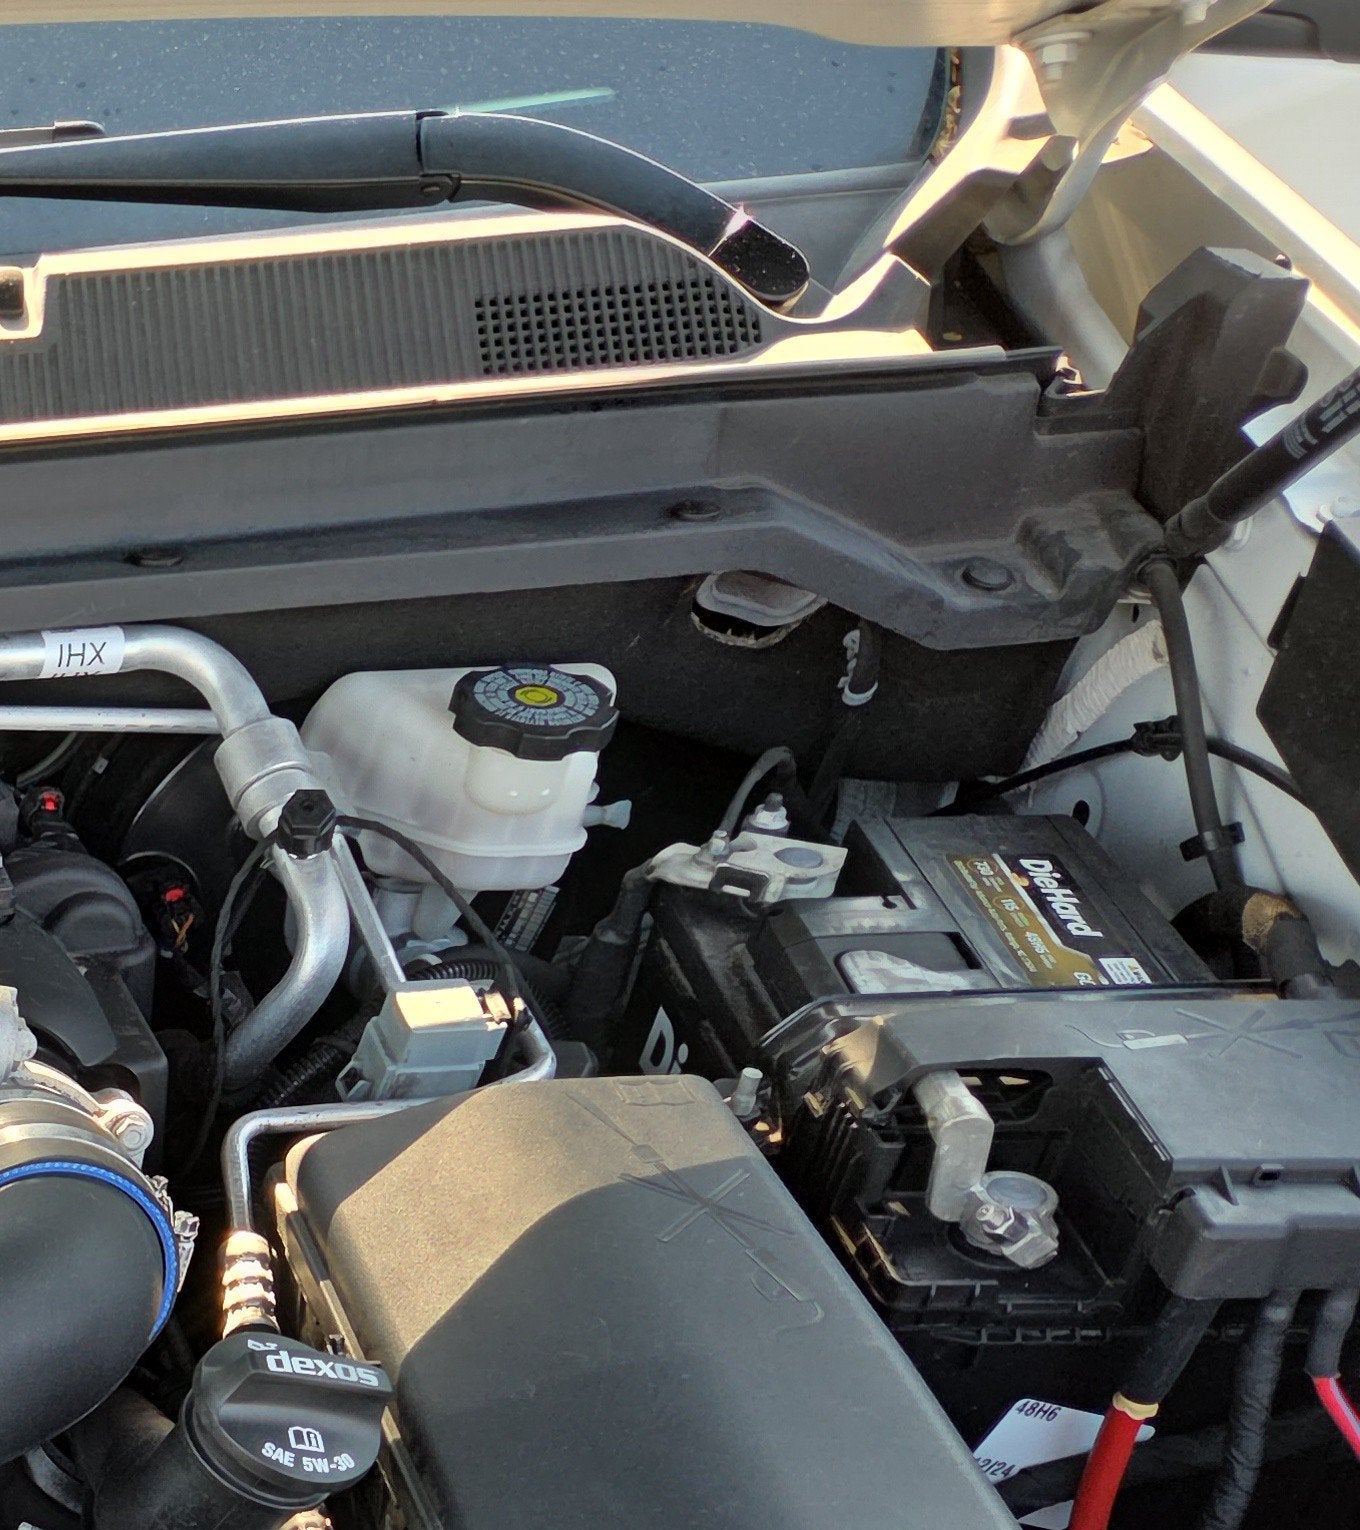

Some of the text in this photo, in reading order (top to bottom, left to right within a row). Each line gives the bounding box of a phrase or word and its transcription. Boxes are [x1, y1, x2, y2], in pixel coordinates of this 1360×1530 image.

[1019, 859, 1103, 937] DieHard
[265, 1350, 379, 1387] dexos
[1014, 1400, 1062, 1422] 48H6
[261, 1441, 355, 1474] SAE 5W-30
